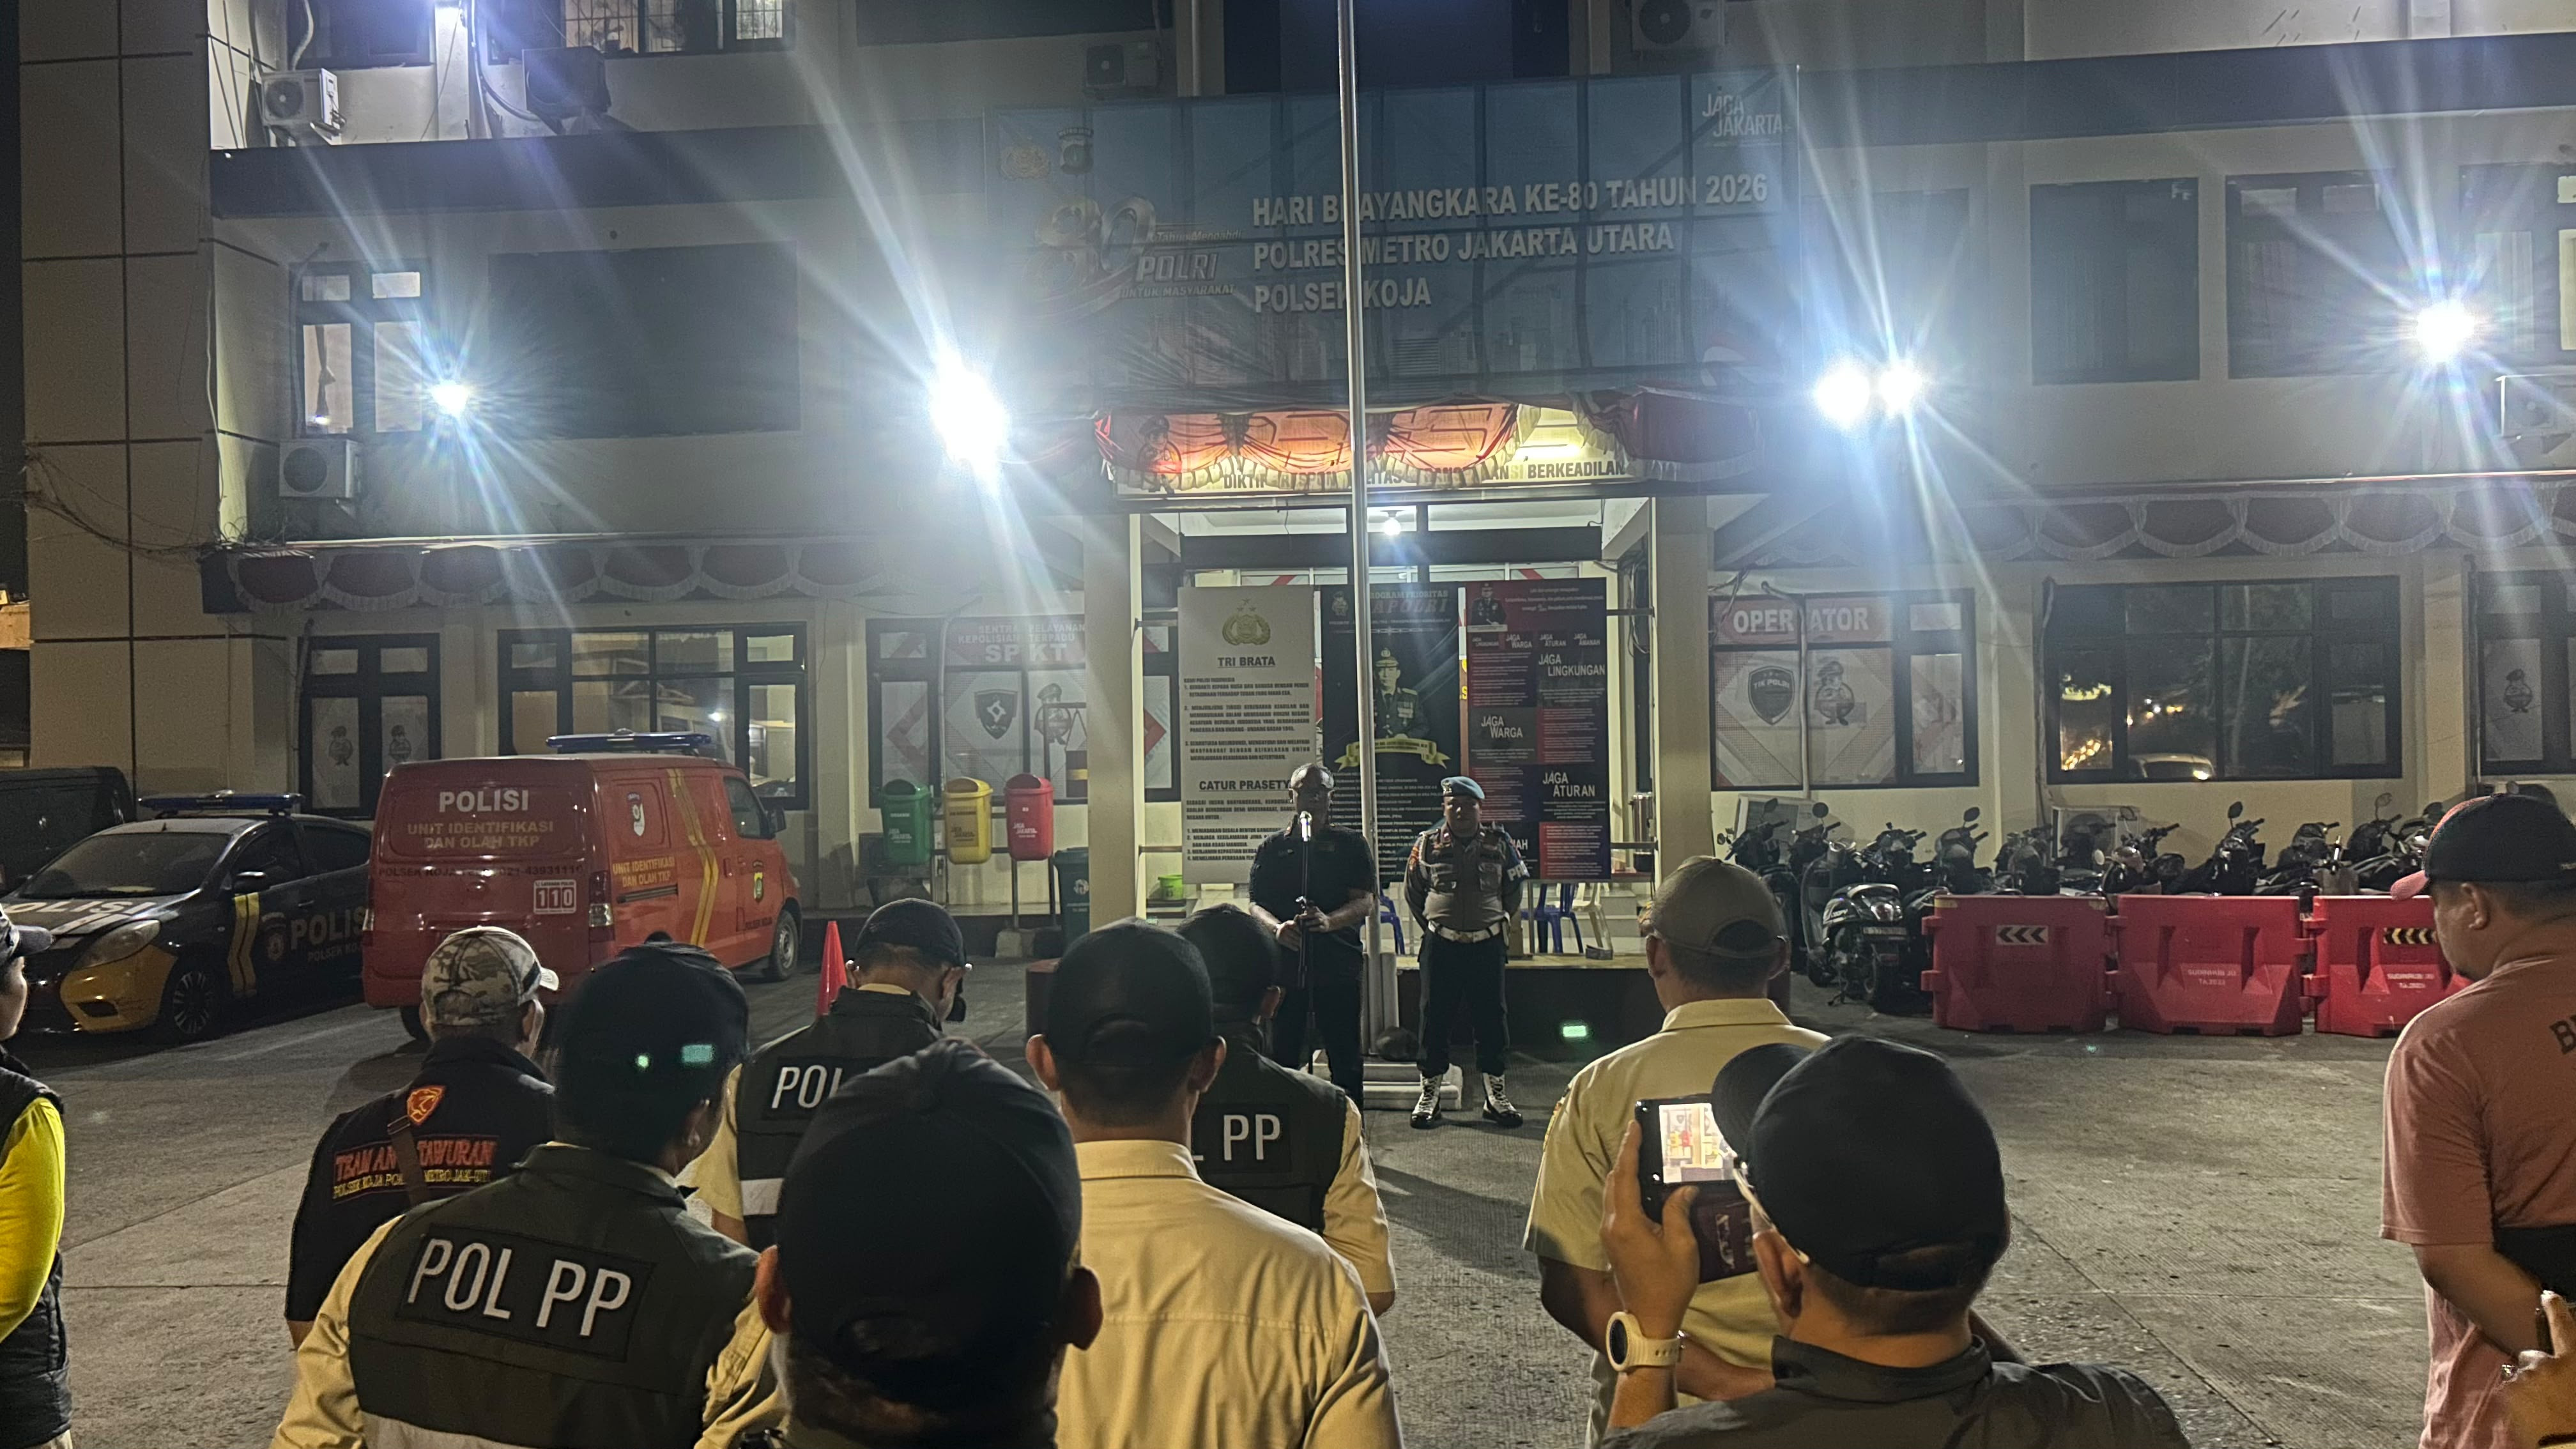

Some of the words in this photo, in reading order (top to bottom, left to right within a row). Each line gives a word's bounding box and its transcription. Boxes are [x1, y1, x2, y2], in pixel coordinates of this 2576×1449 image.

[1702, 93, 1744, 117] JAGA
[1253, 196, 1314, 226] HARI
[1322, 185, 1517, 224] BAYANGKARA
[1526, 182, 1597, 213] KE-80
[1606, 177, 1697, 210] TAHUN
[1706, 173, 1768, 205] 2026
[1361, 232, 1450, 266] METRO
[1458, 226, 1578, 262] JAKARTA
[1587, 222, 1675, 254] UTARA
[1135, 253, 1219, 283] POLRI
[1121, 287, 1160, 300] UNTUK
[1162, 284, 1236, 298] MASYARAKAT
[1364, 277, 1432, 308] KOJA
[1528, 461, 1625, 479] BERKEADILAN
[1370, 591, 1404, 599] OGRAM
[1371, 599, 1449, 614] APOLRI
[1732, 607, 1869, 634] OPERATOR
[1217, 657, 1236, 666] TRI
[1239, 656, 1276, 666] BRATA
[1538, 654, 1562, 666] JAGA
[1547, 664, 1606, 677] LINGKUNGAN
[1481, 716, 1505, 727] JAGA
[1490, 726, 1523, 738] WARGA
[1199, 780, 1236, 790] CATUR
[1239, 779, 1291, 790] PRASETY
[1542, 771, 1569, 785] JAGA
[1552, 785, 1595, 797] ATURAN
[439, 790, 529, 813] POLISI
[408, 822, 444, 835] UNIT
[448, 820, 554, 834] IDENTIFIKASI
[424, 836, 456, 849] DAN
[460, 835, 503, 848] OLAH
[507, 834, 541, 847] TKP
[613, 862, 630, 875] UNIT
[632, 856, 675, 872] IDENTIFIKASI
[622, 874, 638, 887] DAN
[640, 871, 657, 885] OLAH
[658, 870, 671, 880] TKP
[538, 889, 573, 907] 110
[4, 901, 158, 915] OLISI
[291, 905, 365, 950] POLIS
[1223, 1114, 1281, 1162] PP
[336, 1149, 374, 1182] TEAM
[372, 1146, 399, 1172] AN
[417, 1138, 498, 1168] TAWURAN
[332, 1179, 360, 1199] POLSEK
[408, 1238, 512, 1319] POL
[535, 1259, 631, 1337] PP
